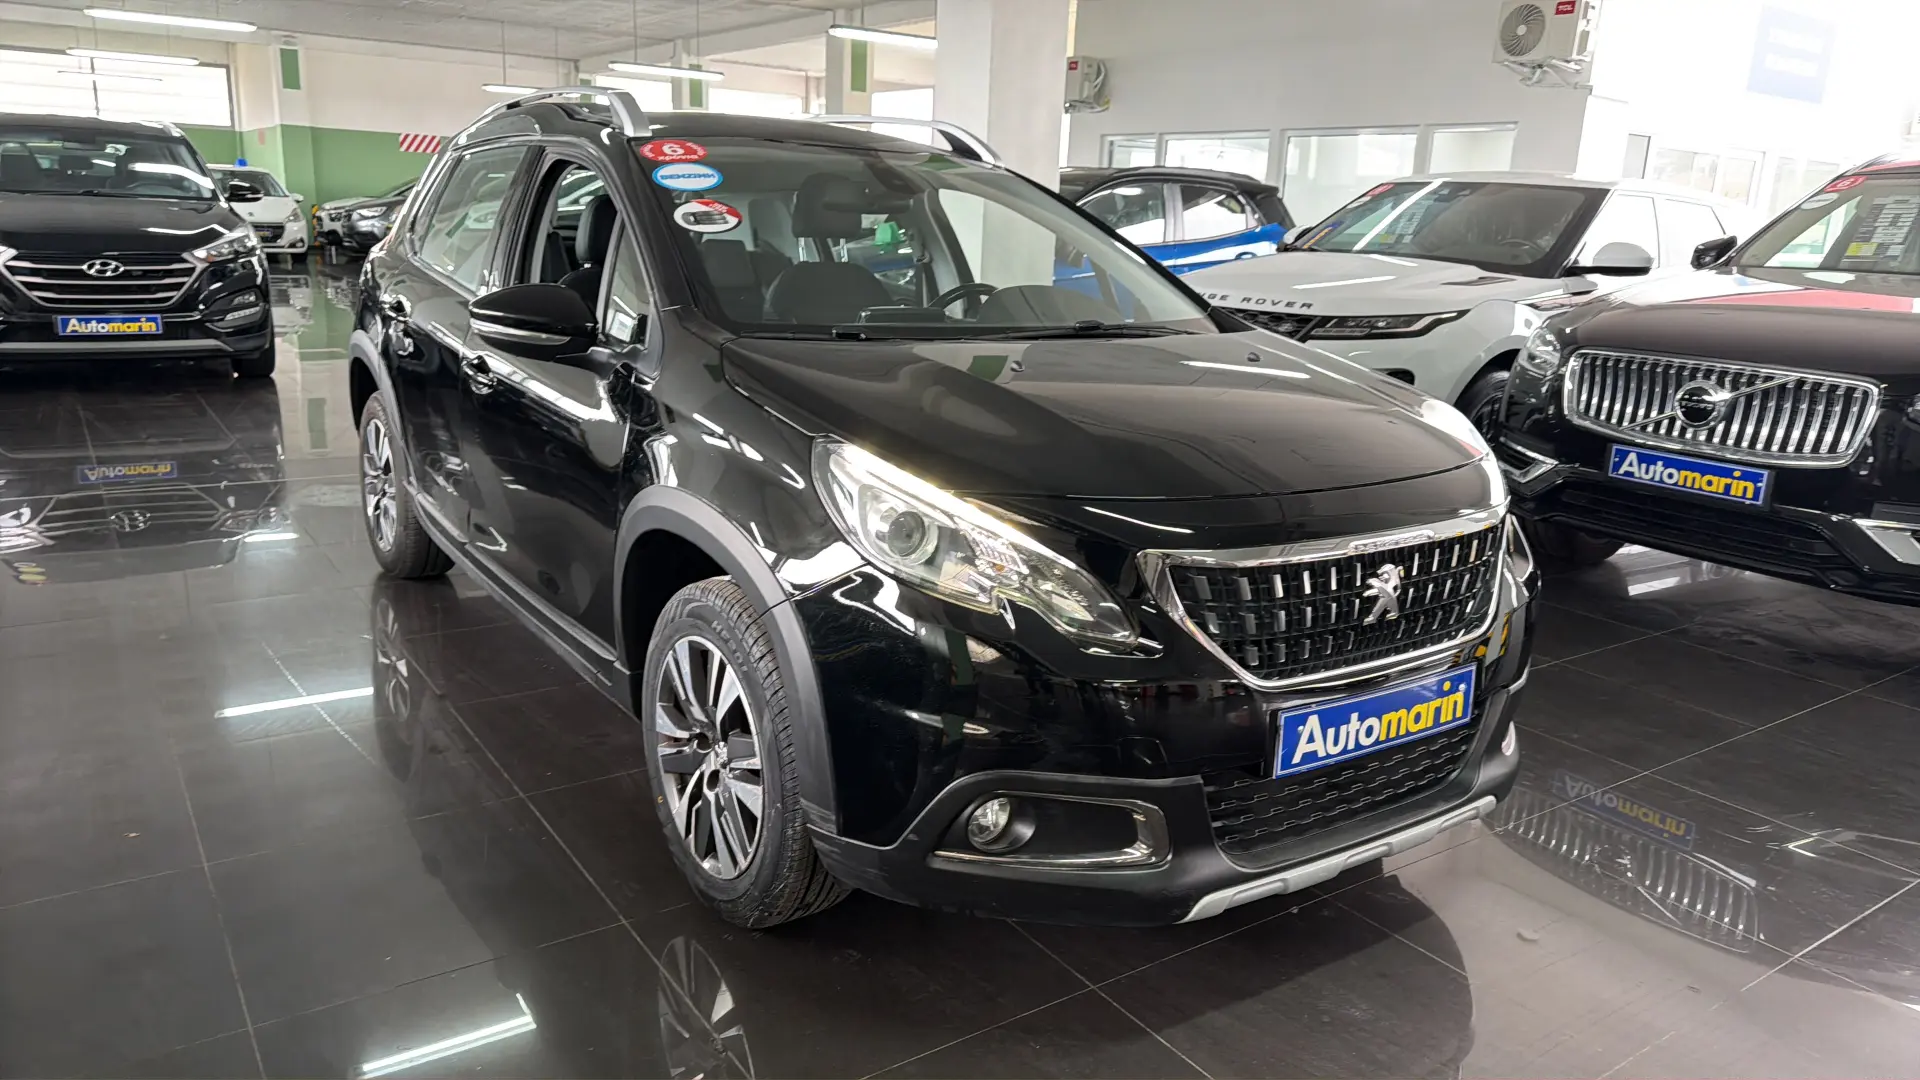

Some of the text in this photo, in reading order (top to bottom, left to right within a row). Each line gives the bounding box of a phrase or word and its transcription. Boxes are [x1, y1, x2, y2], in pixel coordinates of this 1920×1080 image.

[662, 143, 685, 155] 6
[1240, 296, 1314, 310] ROVER
[66, 318, 157, 333] Automarin
[1618, 452, 1755, 499] Automarin
[1291, 681, 1465, 765] Automarin
